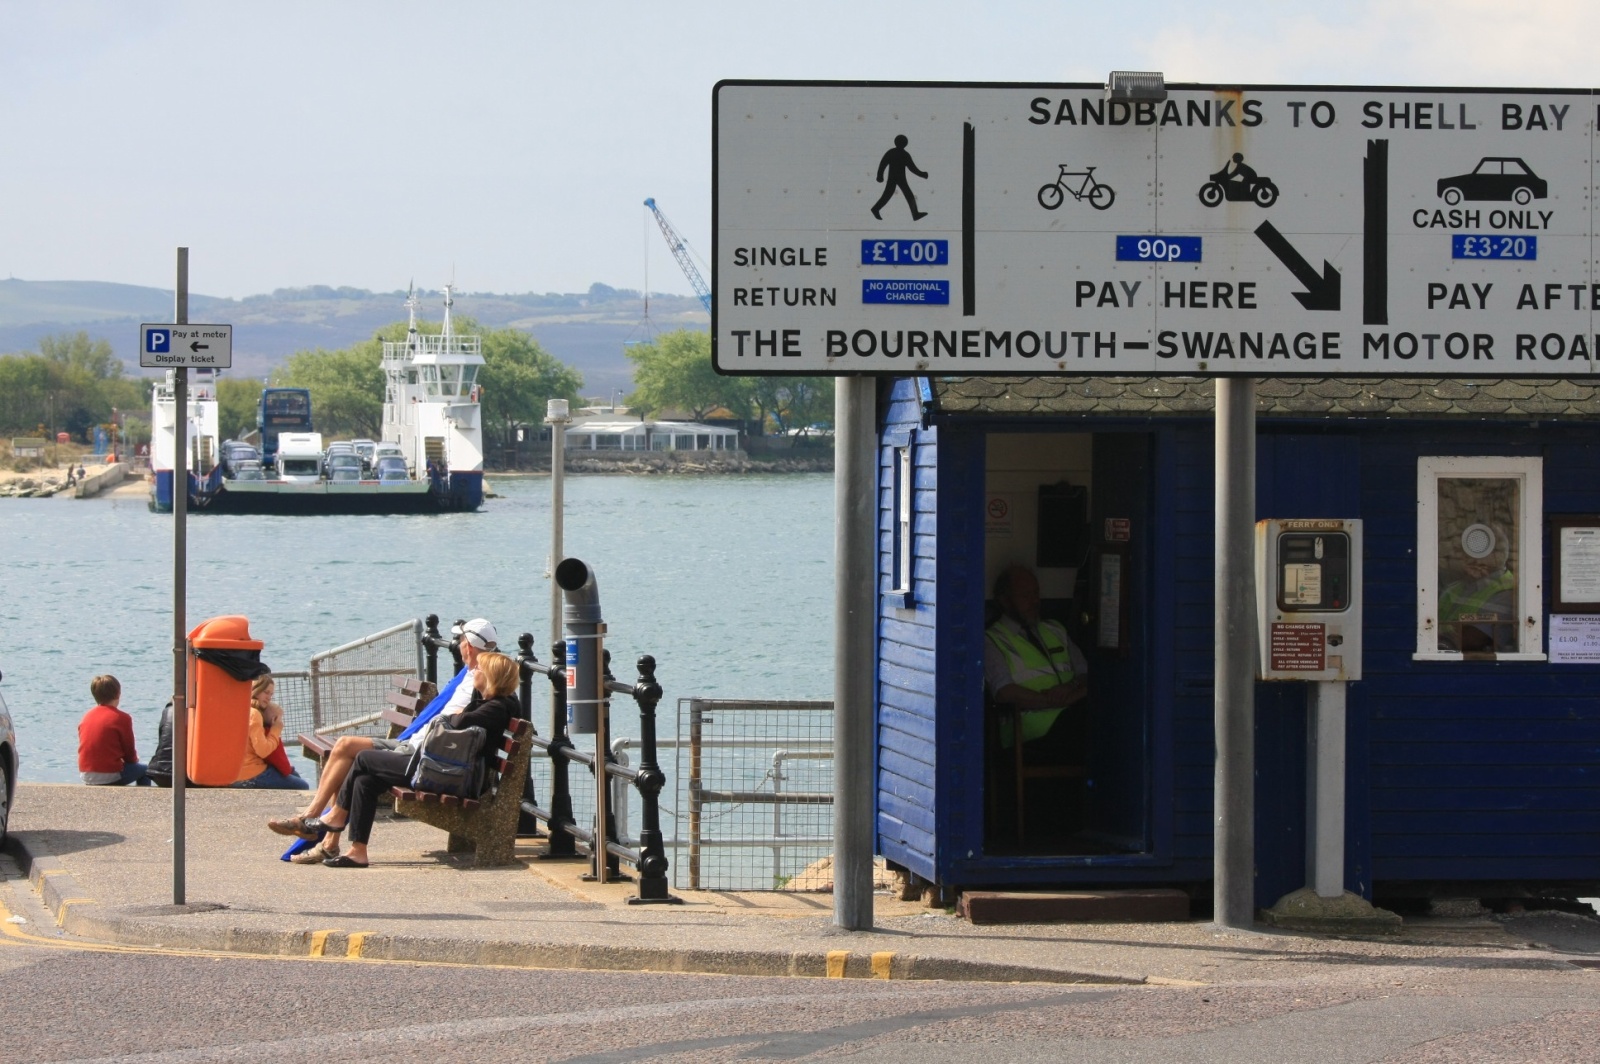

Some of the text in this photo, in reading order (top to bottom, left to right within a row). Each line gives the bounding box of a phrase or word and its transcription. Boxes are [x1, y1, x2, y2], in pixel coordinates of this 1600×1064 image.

[1028, 96, 1263, 127] SANDBANKS
[1286, 101, 1336, 128] TO
[1361, 101, 1476, 130] SHELL
[1502, 103, 1570, 132] BAY
[1412, 208, 1554, 230] CASH ONLY
[734, 247, 828, 266] SINGLE
[1137, 240, 1181, 262] 90p
[734, 286, 837, 307] RETURN
[869, 282, 942, 292] NO ADDITIONAL
[886, 292, 926, 302] CHARGE
[1076, 281, 1258, 308] PAY HERE
[1428, 283, 1494, 310] PAY
[152, 332, 165, 350] P
[172, 330, 188, 339] Pay
[731, 330, 801, 357] THE
[1363, 332, 1494, 361] MOTOR
[1516, 332, 1600, 361] ROA
[156, 355, 186, 363] Display
